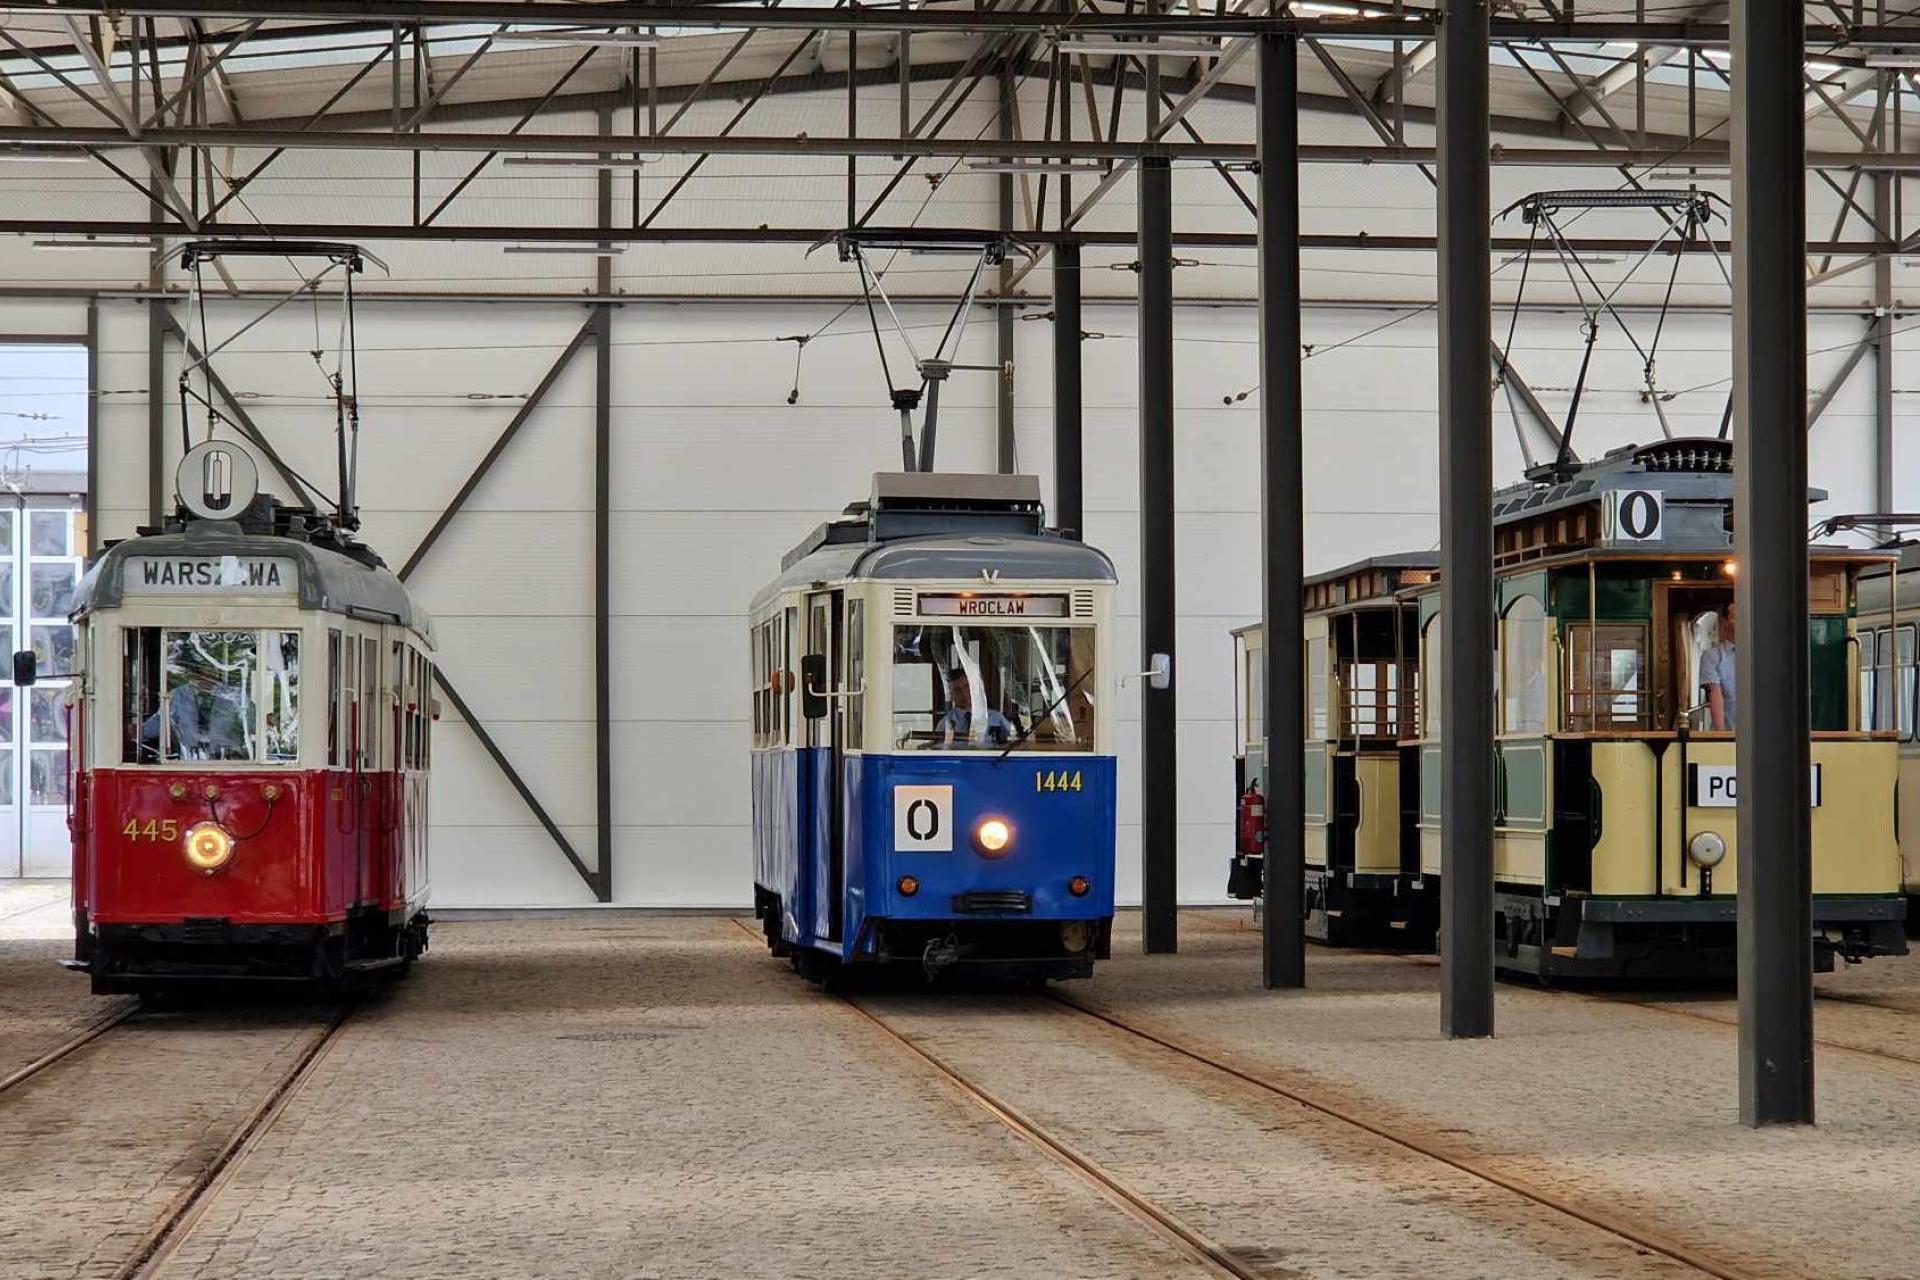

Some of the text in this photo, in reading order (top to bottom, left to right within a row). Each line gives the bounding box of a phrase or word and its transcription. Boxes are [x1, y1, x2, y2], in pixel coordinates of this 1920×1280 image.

[1619, 490, 1660, 539] 0
[144, 561, 281, 586] WARSWA
[959, 600, 1024, 615] WROCŁAW
[1036, 771, 1082, 792] 1444
[123, 818, 178, 841] 445
[907, 799, 939, 841] 0
